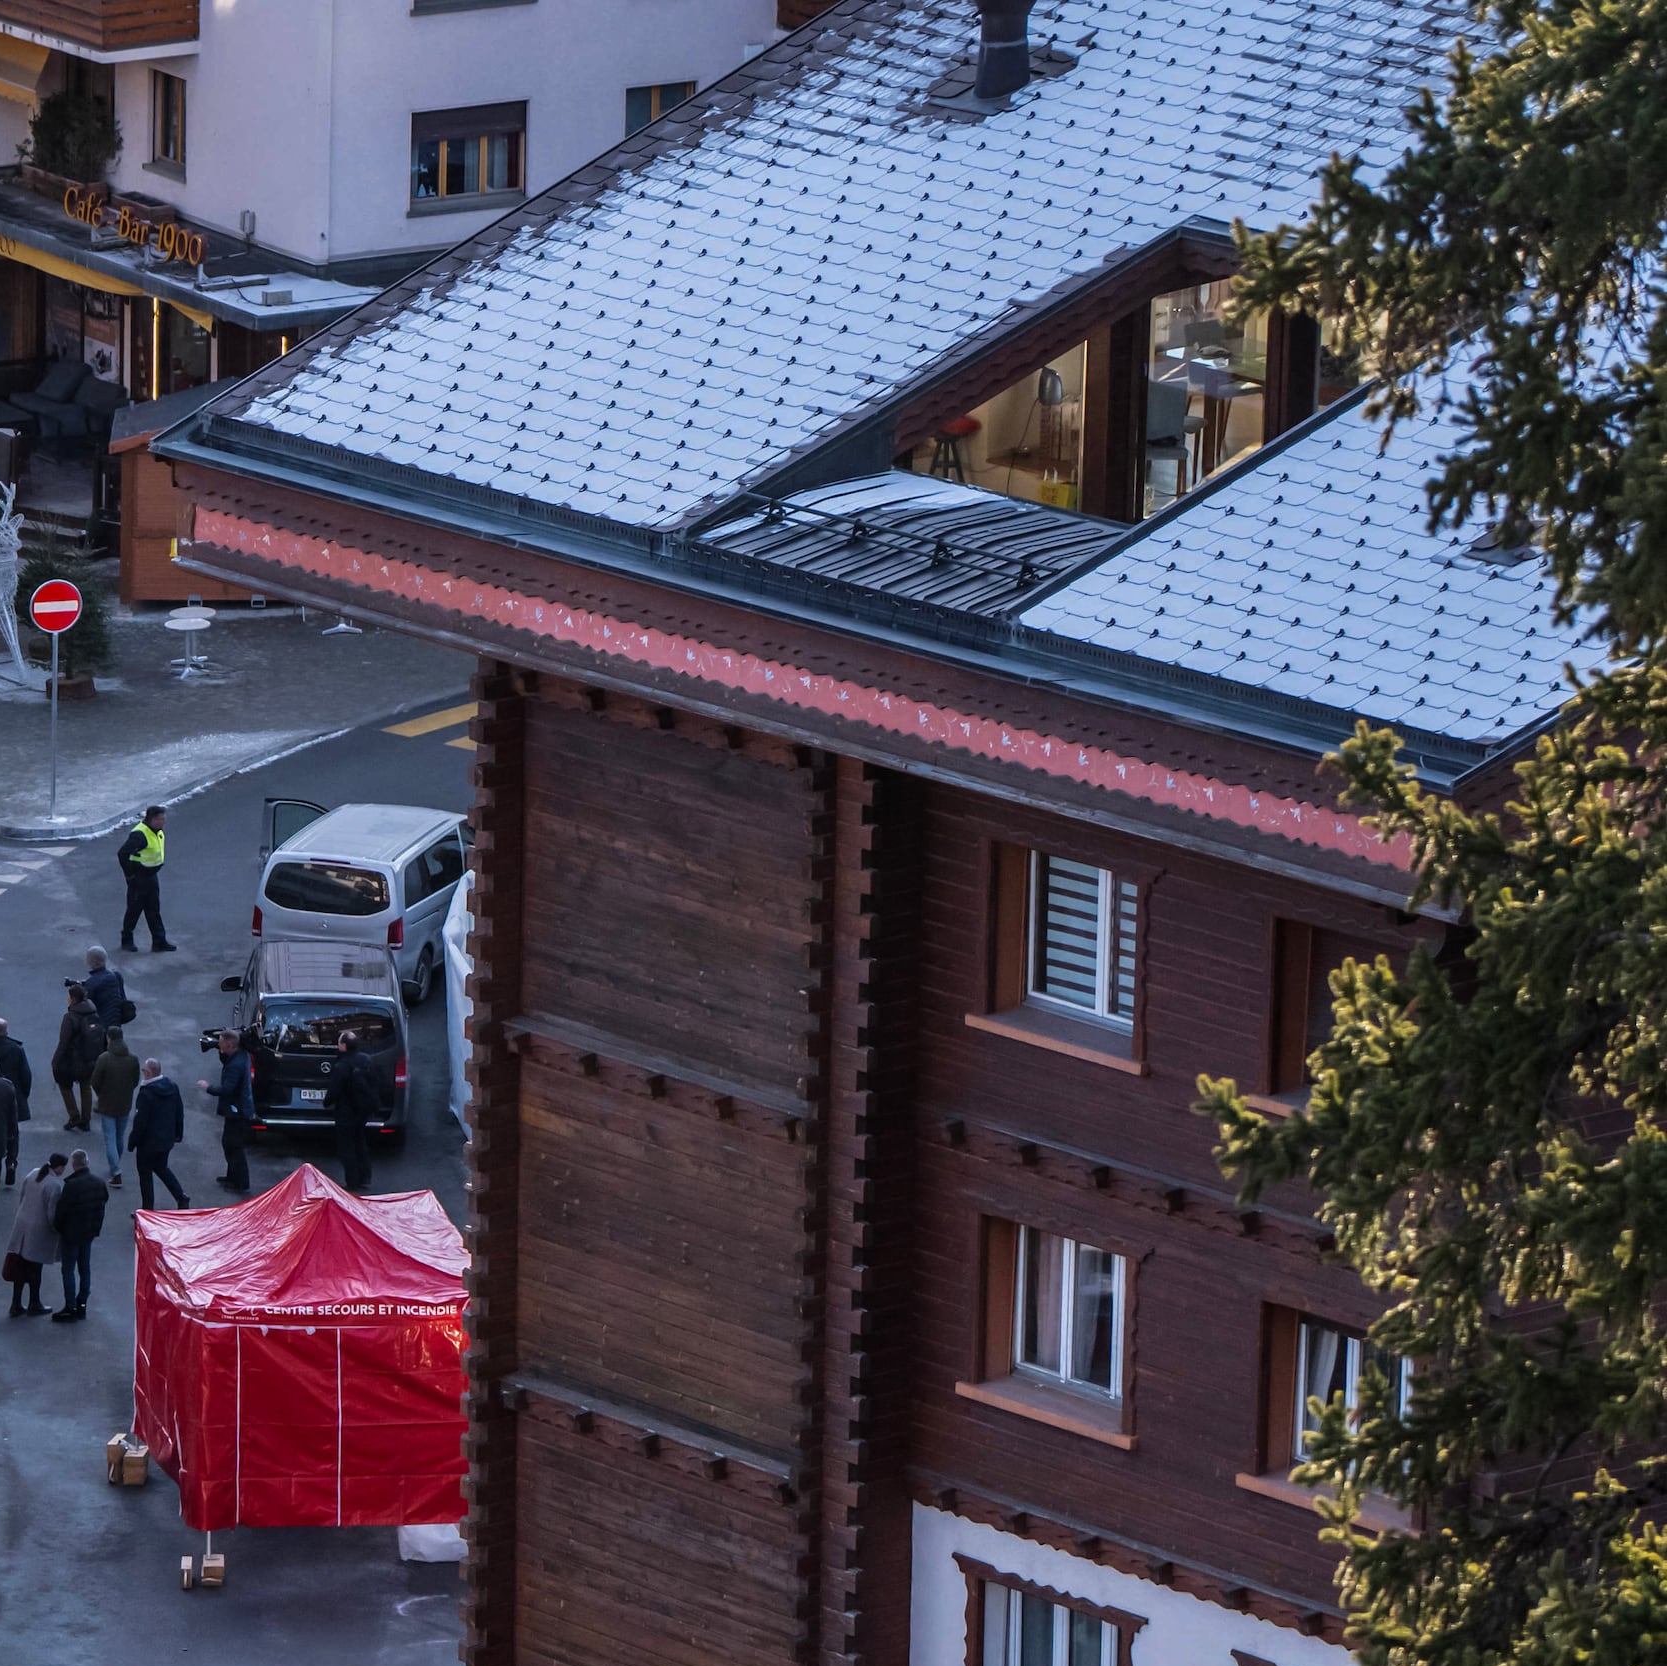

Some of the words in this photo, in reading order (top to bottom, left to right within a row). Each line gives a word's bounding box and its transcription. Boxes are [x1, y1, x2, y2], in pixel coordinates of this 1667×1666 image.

[63, 186, 103, 228] Café
[118, 206, 149, 246] Bar
[157, 223, 205, 265] 1900
[265, 1305, 314, 1316] CENTRE
[317, 1303, 375, 1316] SECOURS
[378, 1304, 393, 1315] ET
[396, 1304, 458, 1316] INCENDIE
